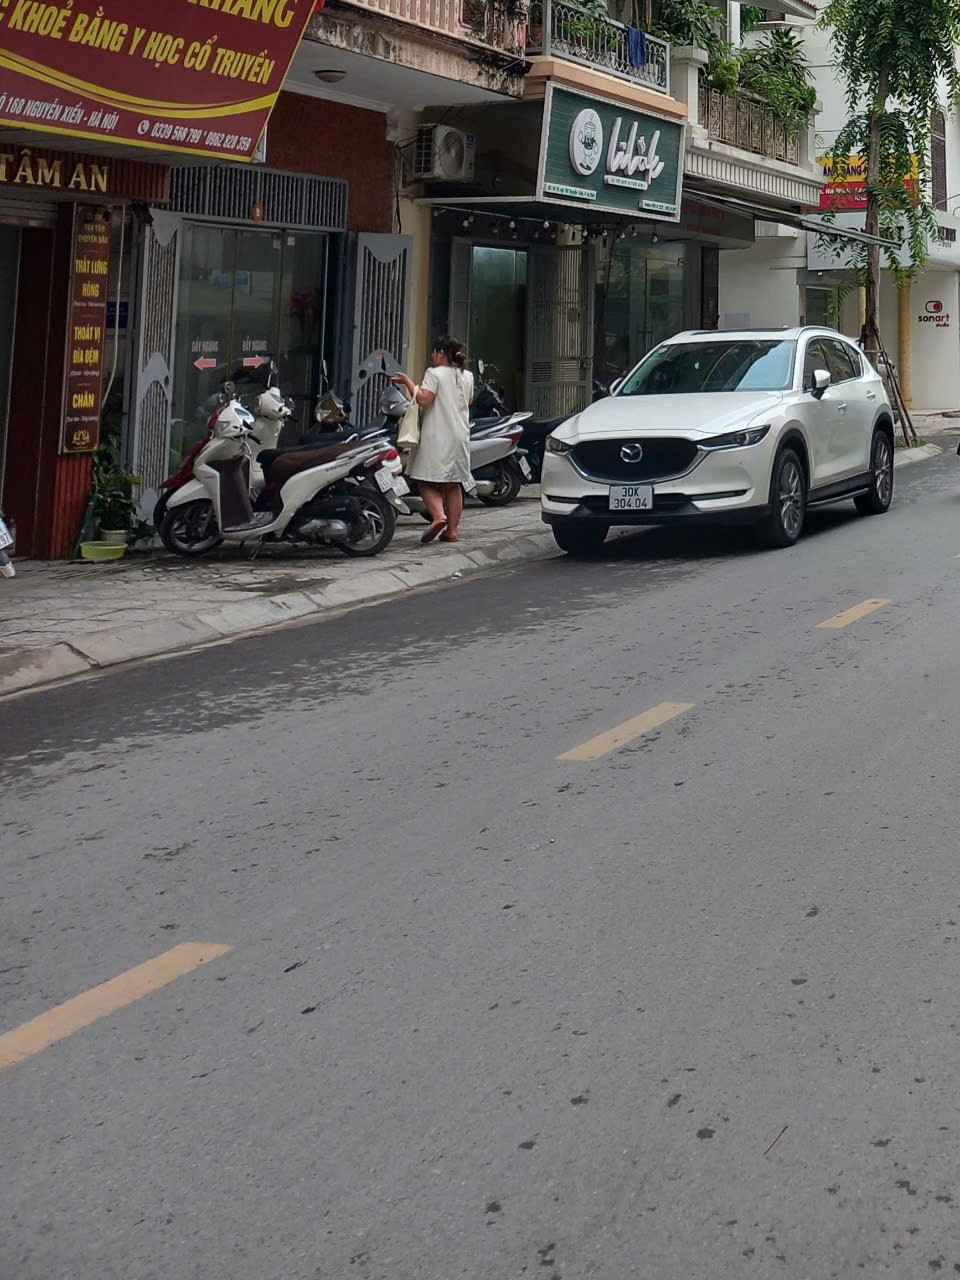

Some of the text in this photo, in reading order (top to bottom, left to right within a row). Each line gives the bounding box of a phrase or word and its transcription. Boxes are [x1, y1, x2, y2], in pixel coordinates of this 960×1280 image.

[68, 5, 129, 53] BẰNG
[128, 27, 147, 56] Y
[142, 31, 184, 68] HỌC
[183, 34, 218, 71] CỔ
[210, 48, 275, 85] TRUYỀN
[87, 108, 104, 128] HÀ
[100, 111, 119, 133] NỘI
[151, 122, 173, 139] 0339
[0, 148, 109, 192] TÂM AN
[918, 313, 950, 322] sonart
[622, 486, 640, 497] 30K
[614, 498, 647, 509] 304.04
